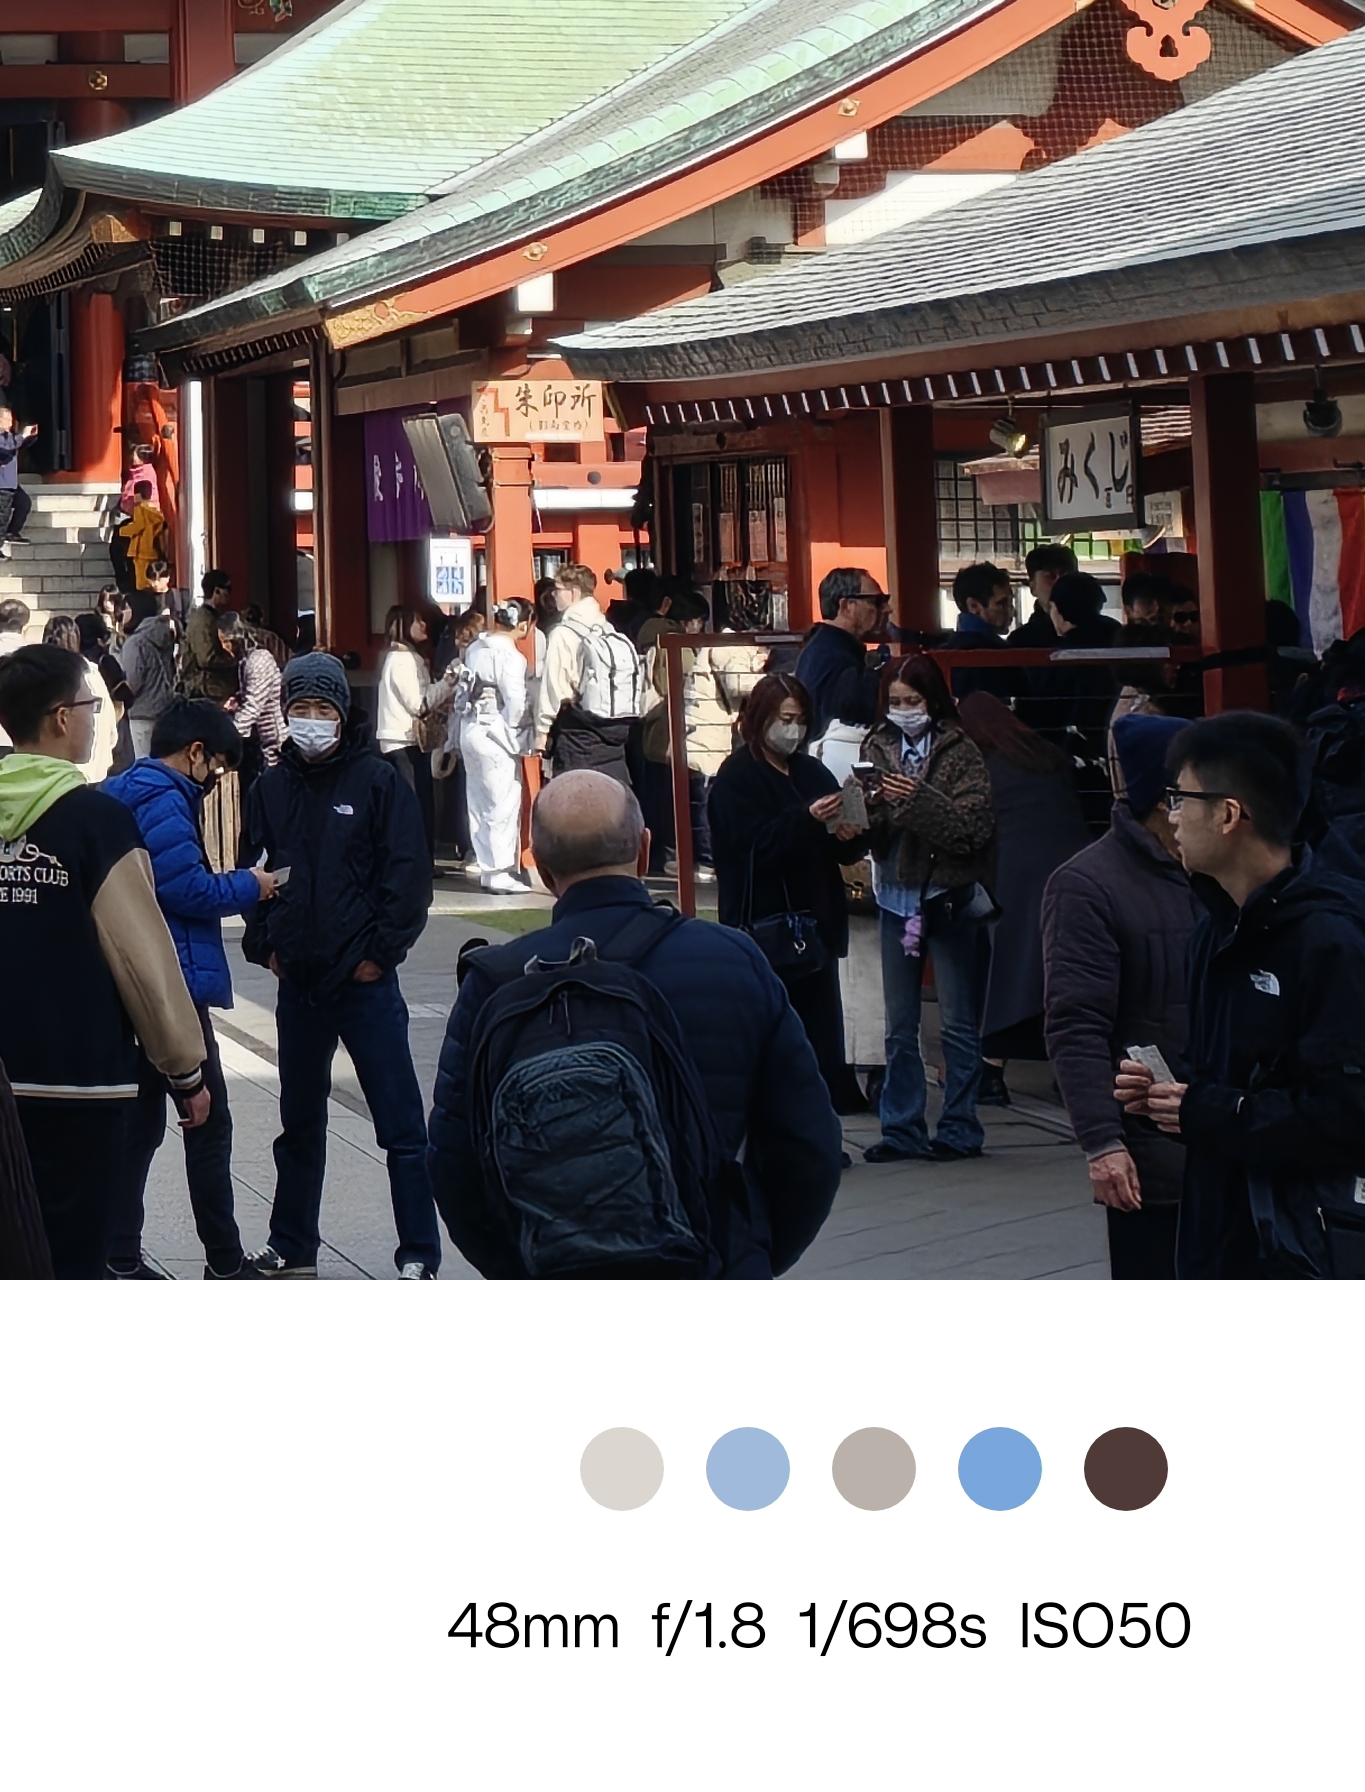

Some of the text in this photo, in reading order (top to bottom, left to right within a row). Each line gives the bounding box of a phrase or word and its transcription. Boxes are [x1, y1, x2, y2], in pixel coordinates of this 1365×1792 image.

[515, 383, 596, 419] 朱印所
[1057, 431, 1129, 504] みくじ
[34, 867, 69, 887] CLUB
